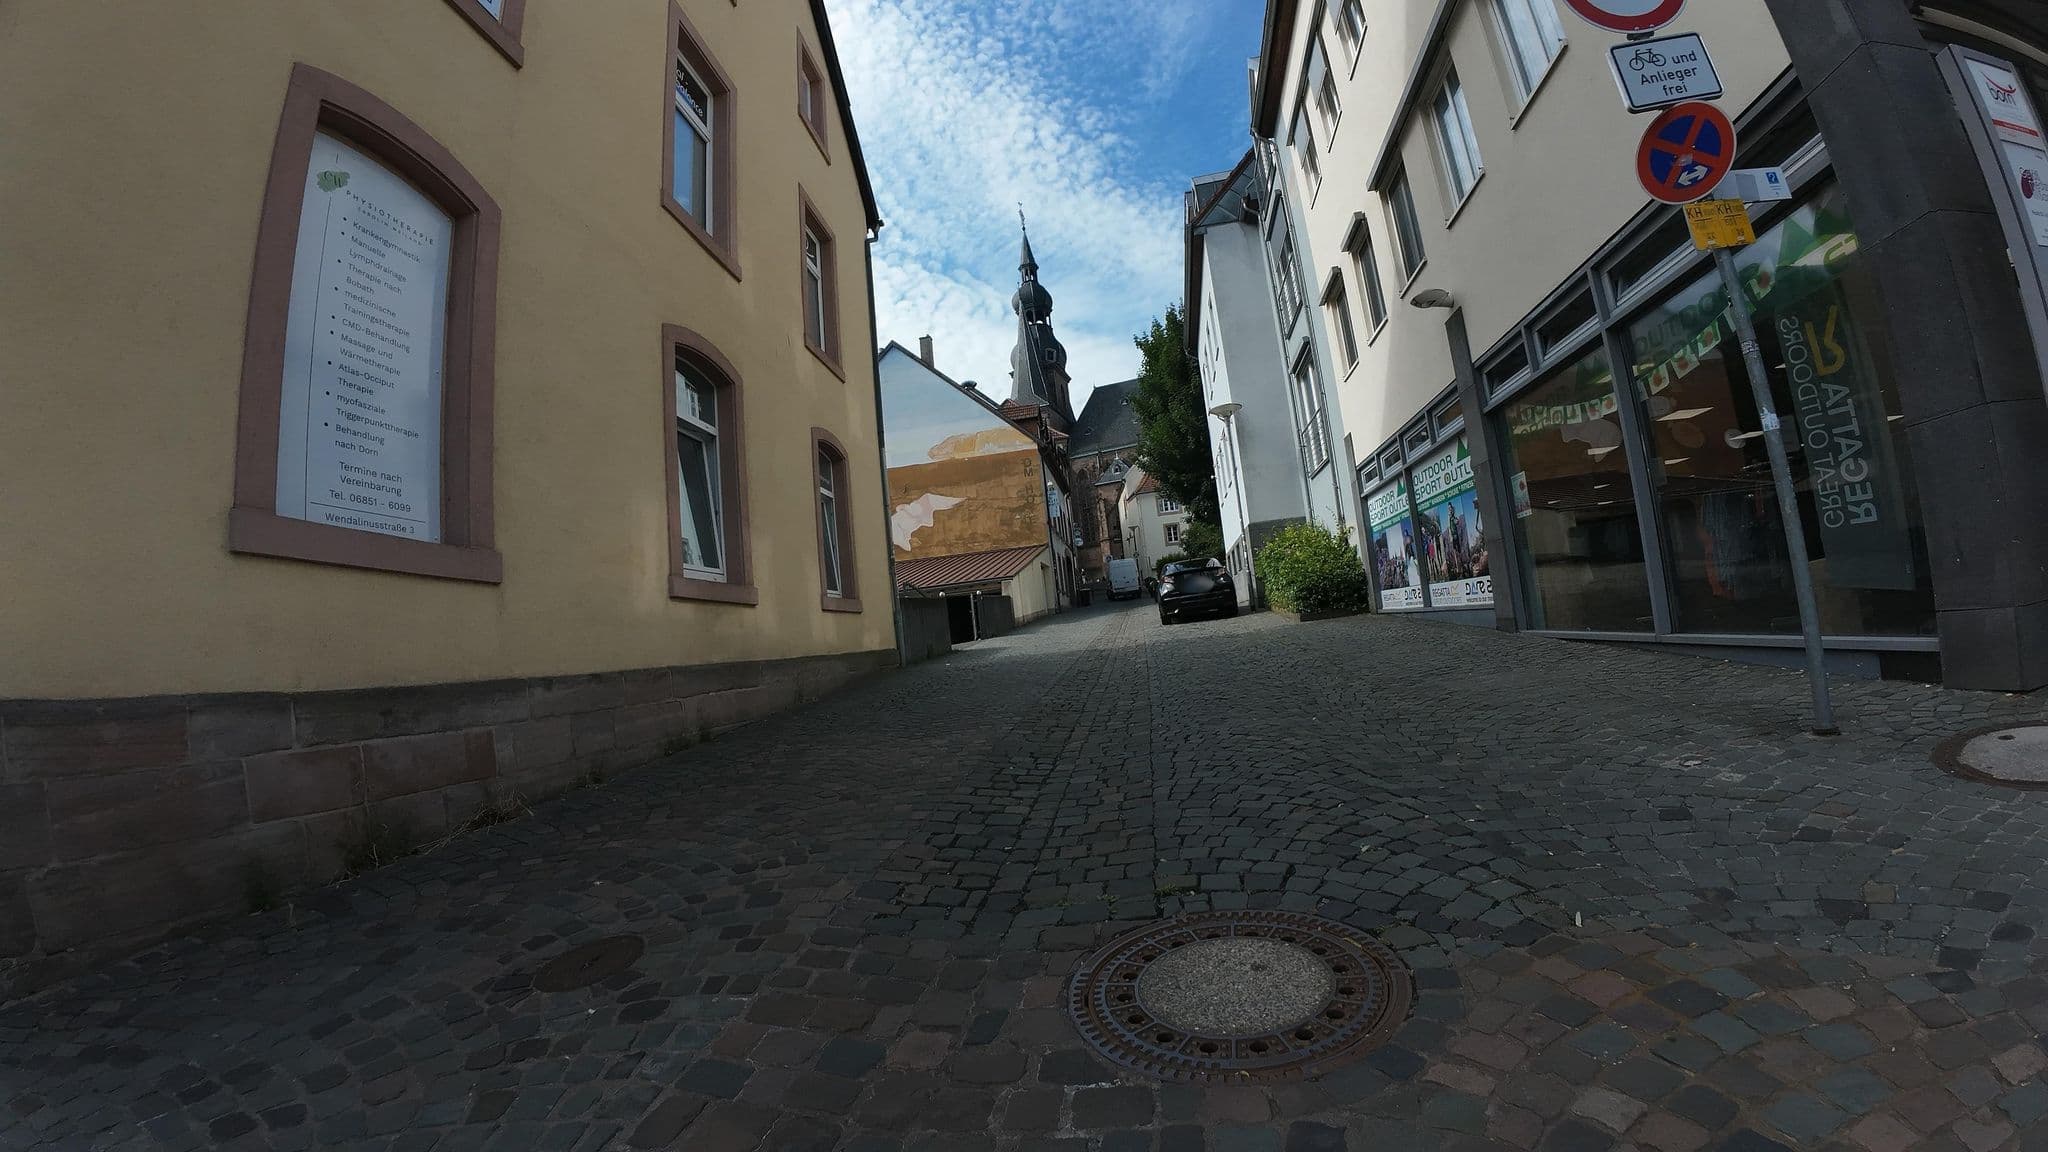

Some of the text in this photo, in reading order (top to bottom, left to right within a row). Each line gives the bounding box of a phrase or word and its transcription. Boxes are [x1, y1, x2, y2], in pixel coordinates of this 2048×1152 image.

[1671, 50, 1697, 65] und
[1640, 66, 1698, 86] Anlieger
[1662, 82, 1688, 97] frei
[346, 189, 434, 246] PHYSIOTHERAPIE
[350, 235, 386, 259] Manuelle
[352, 221, 421, 264] Krankengymnastik
[347, 262, 402, 295] Therapie nach
[349, 249, 407, 283] Lymphdrainage
[346, 276, 375, 295] Bobath
[344, 290, 397, 318] medizinische
[343, 302, 410, 337] Trainingstherapie
[341, 333, 393, 360] Massage und
[342, 318, 410, 354] CMD-Behandlung
[340, 347, 400, 376] Wärmetherapie
[338, 363, 395, 389] Atlas-Occiput
[338, 377, 374, 396] Therapie
[337, 394, 386, 415] myofasziale
[335, 424, 385, 446] Behandlung
[336, 407, 420, 439] Triggerpunkttherapie
[335, 439, 379, 457] nach Dorn
[339, 461, 402, 484] Termine nach
[1413, 454, 1454, 486] OUTDOOR
[1415, 477, 1441, 500] SPORT
[1444, 462, 1471, 486] OUTL
[340, 475, 402, 497] Vereinbarung
[329, 489, 346, 502] Tel.
[350, 493, 377, 507] 06851
[388, 502, 411, 513] 6099
[1368, 490, 1396, 513] OUTDOOR
[1370, 507, 1389, 524] SPORT
[1389, 497, 1409, 514] OUTLE
[325, 512, 415, 534] Wendalinusstraße 3
